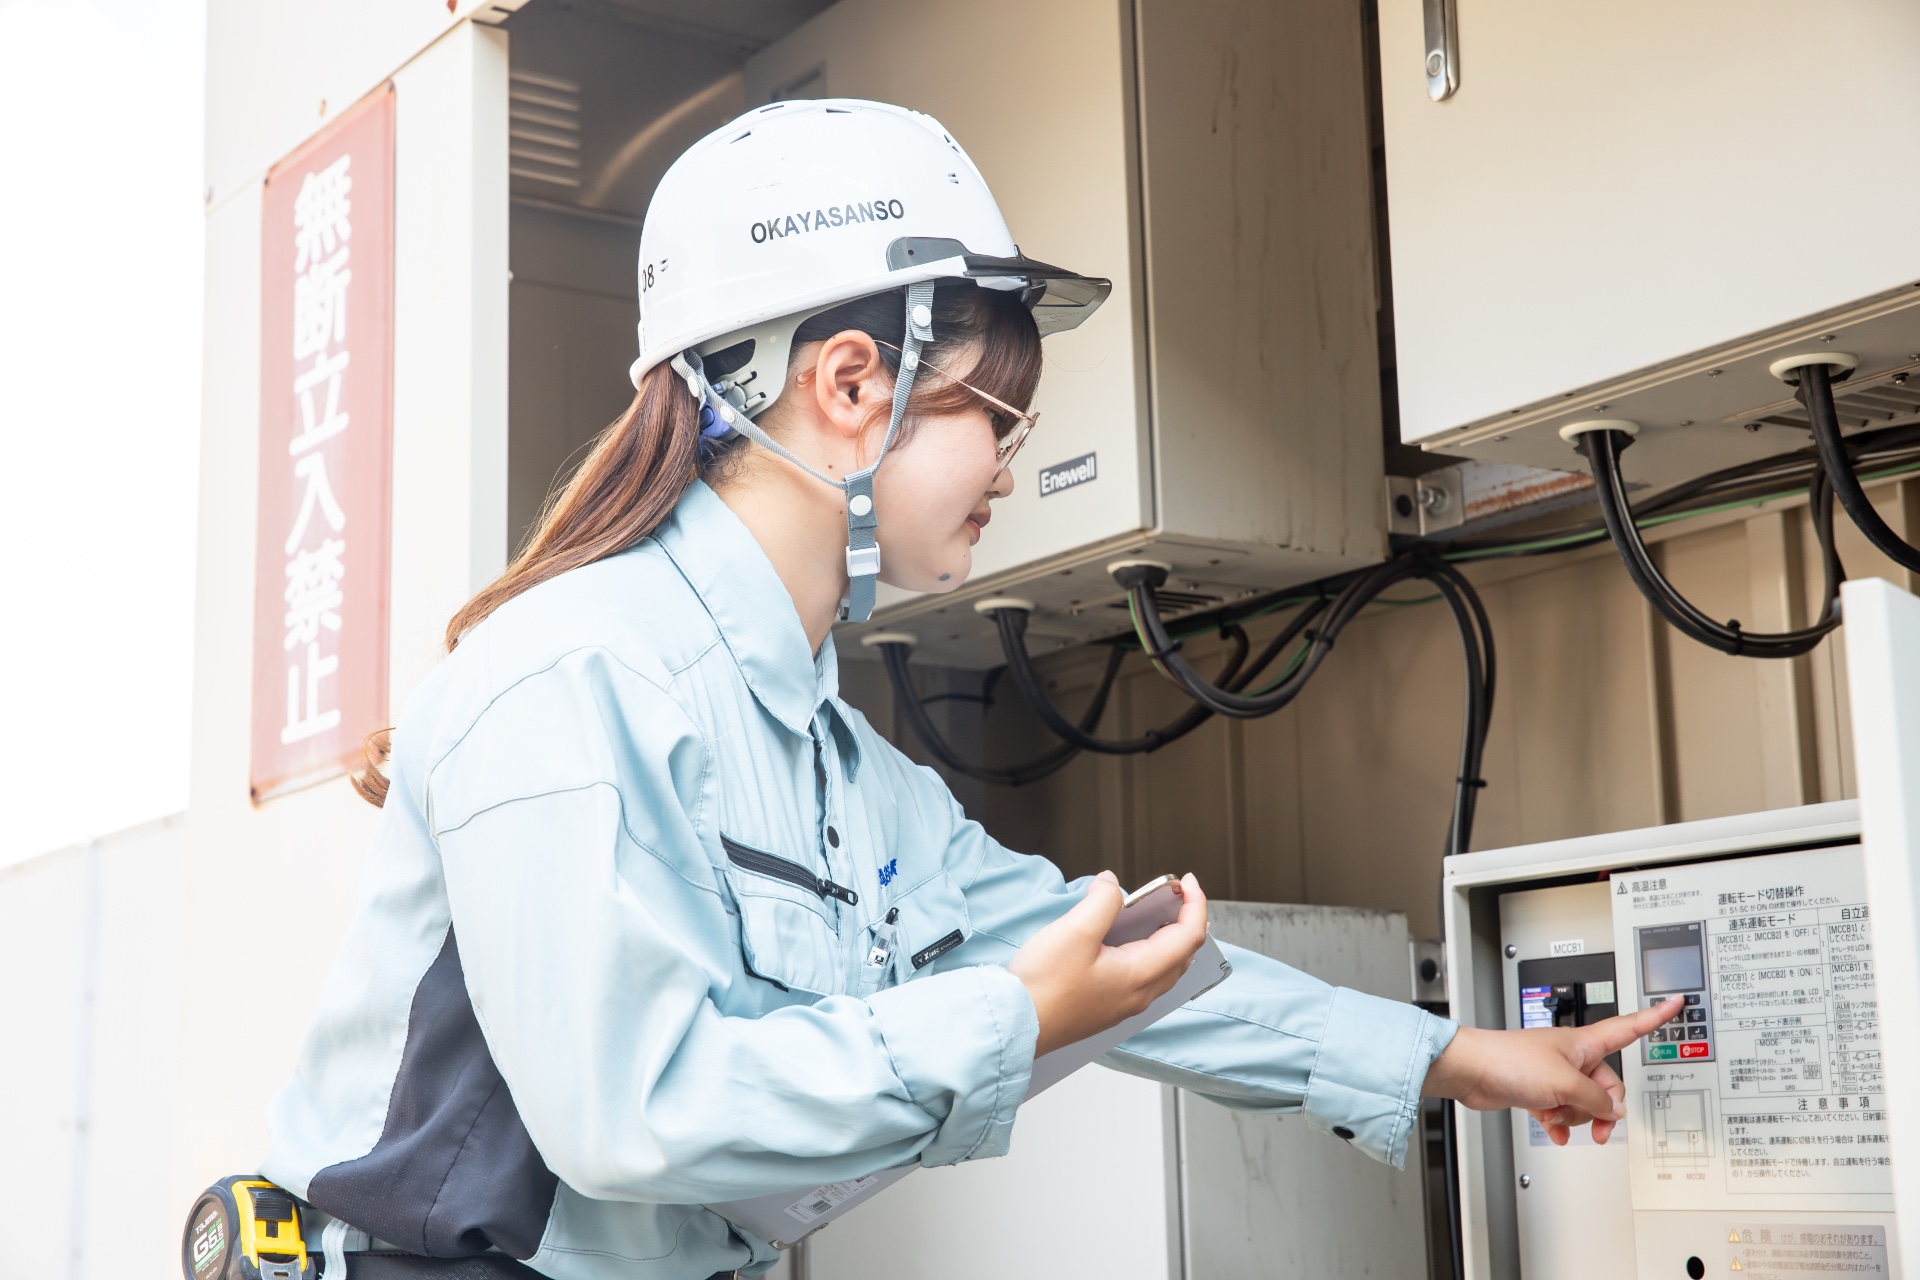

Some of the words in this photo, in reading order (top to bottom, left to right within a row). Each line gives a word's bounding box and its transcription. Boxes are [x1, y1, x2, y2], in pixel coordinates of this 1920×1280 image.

[751, 198, 904, 245] OKAYASANSO
[281, 154, 351, 745] 無断立入禁止
[1041, 456, 1095, 492] Enewell
[1632, 878, 1667, 893] 高温注意
[1718, 885, 1804, 905] 運転モード切替操作
[1728, 913, 1796, 931] 連系運転モード
[1553, 942, 1582, 955] MCCB1
[1690, 1046, 1705, 1055] STOP
